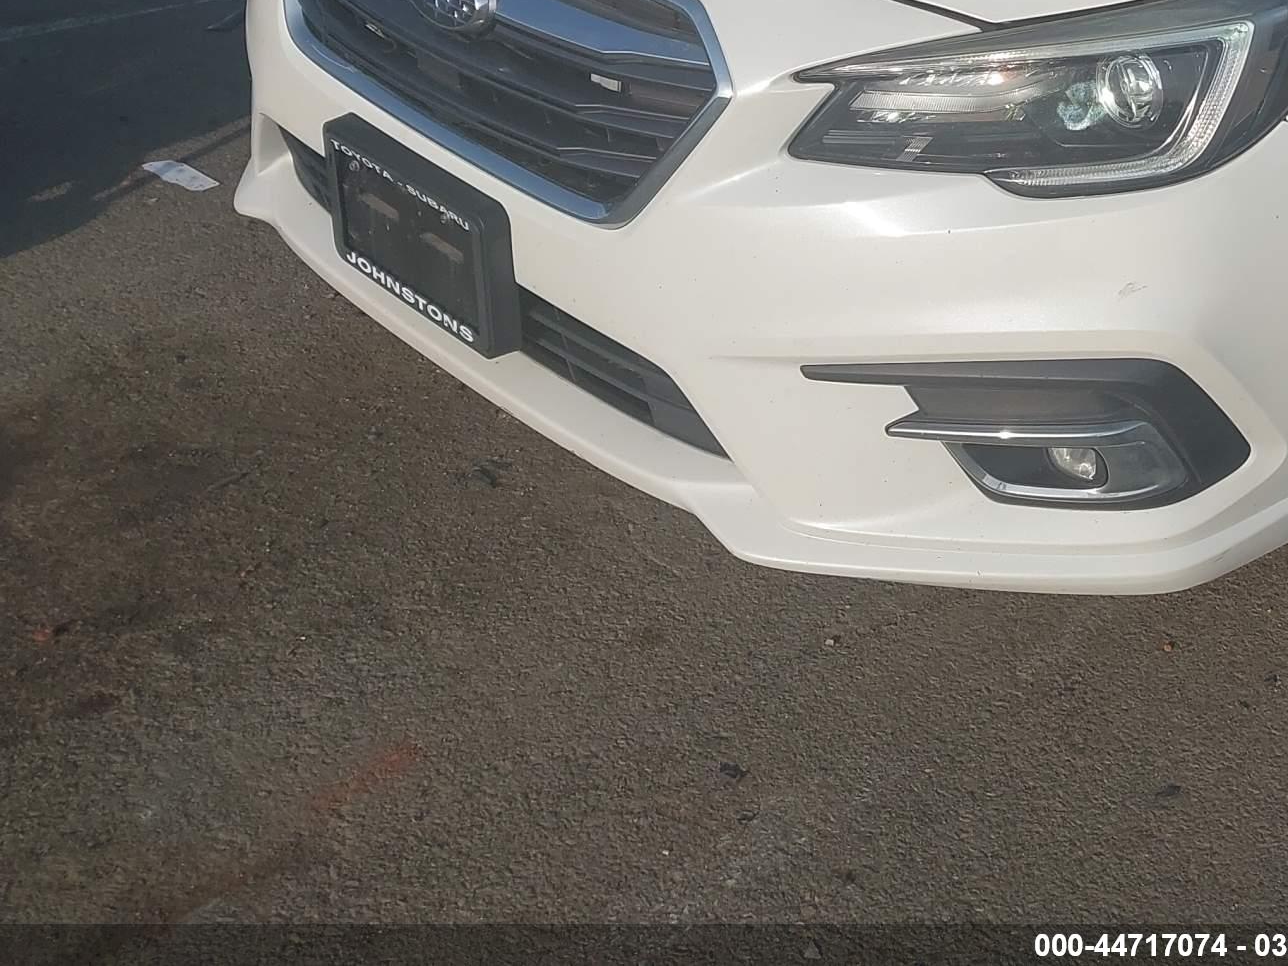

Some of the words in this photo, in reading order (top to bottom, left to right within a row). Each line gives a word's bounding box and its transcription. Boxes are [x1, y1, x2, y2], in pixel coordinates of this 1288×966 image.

[330, 138, 395, 183] TOYOTA
[405, 184, 470, 231] SUBARU
[346, 251, 475, 343] JOHNSTONS
